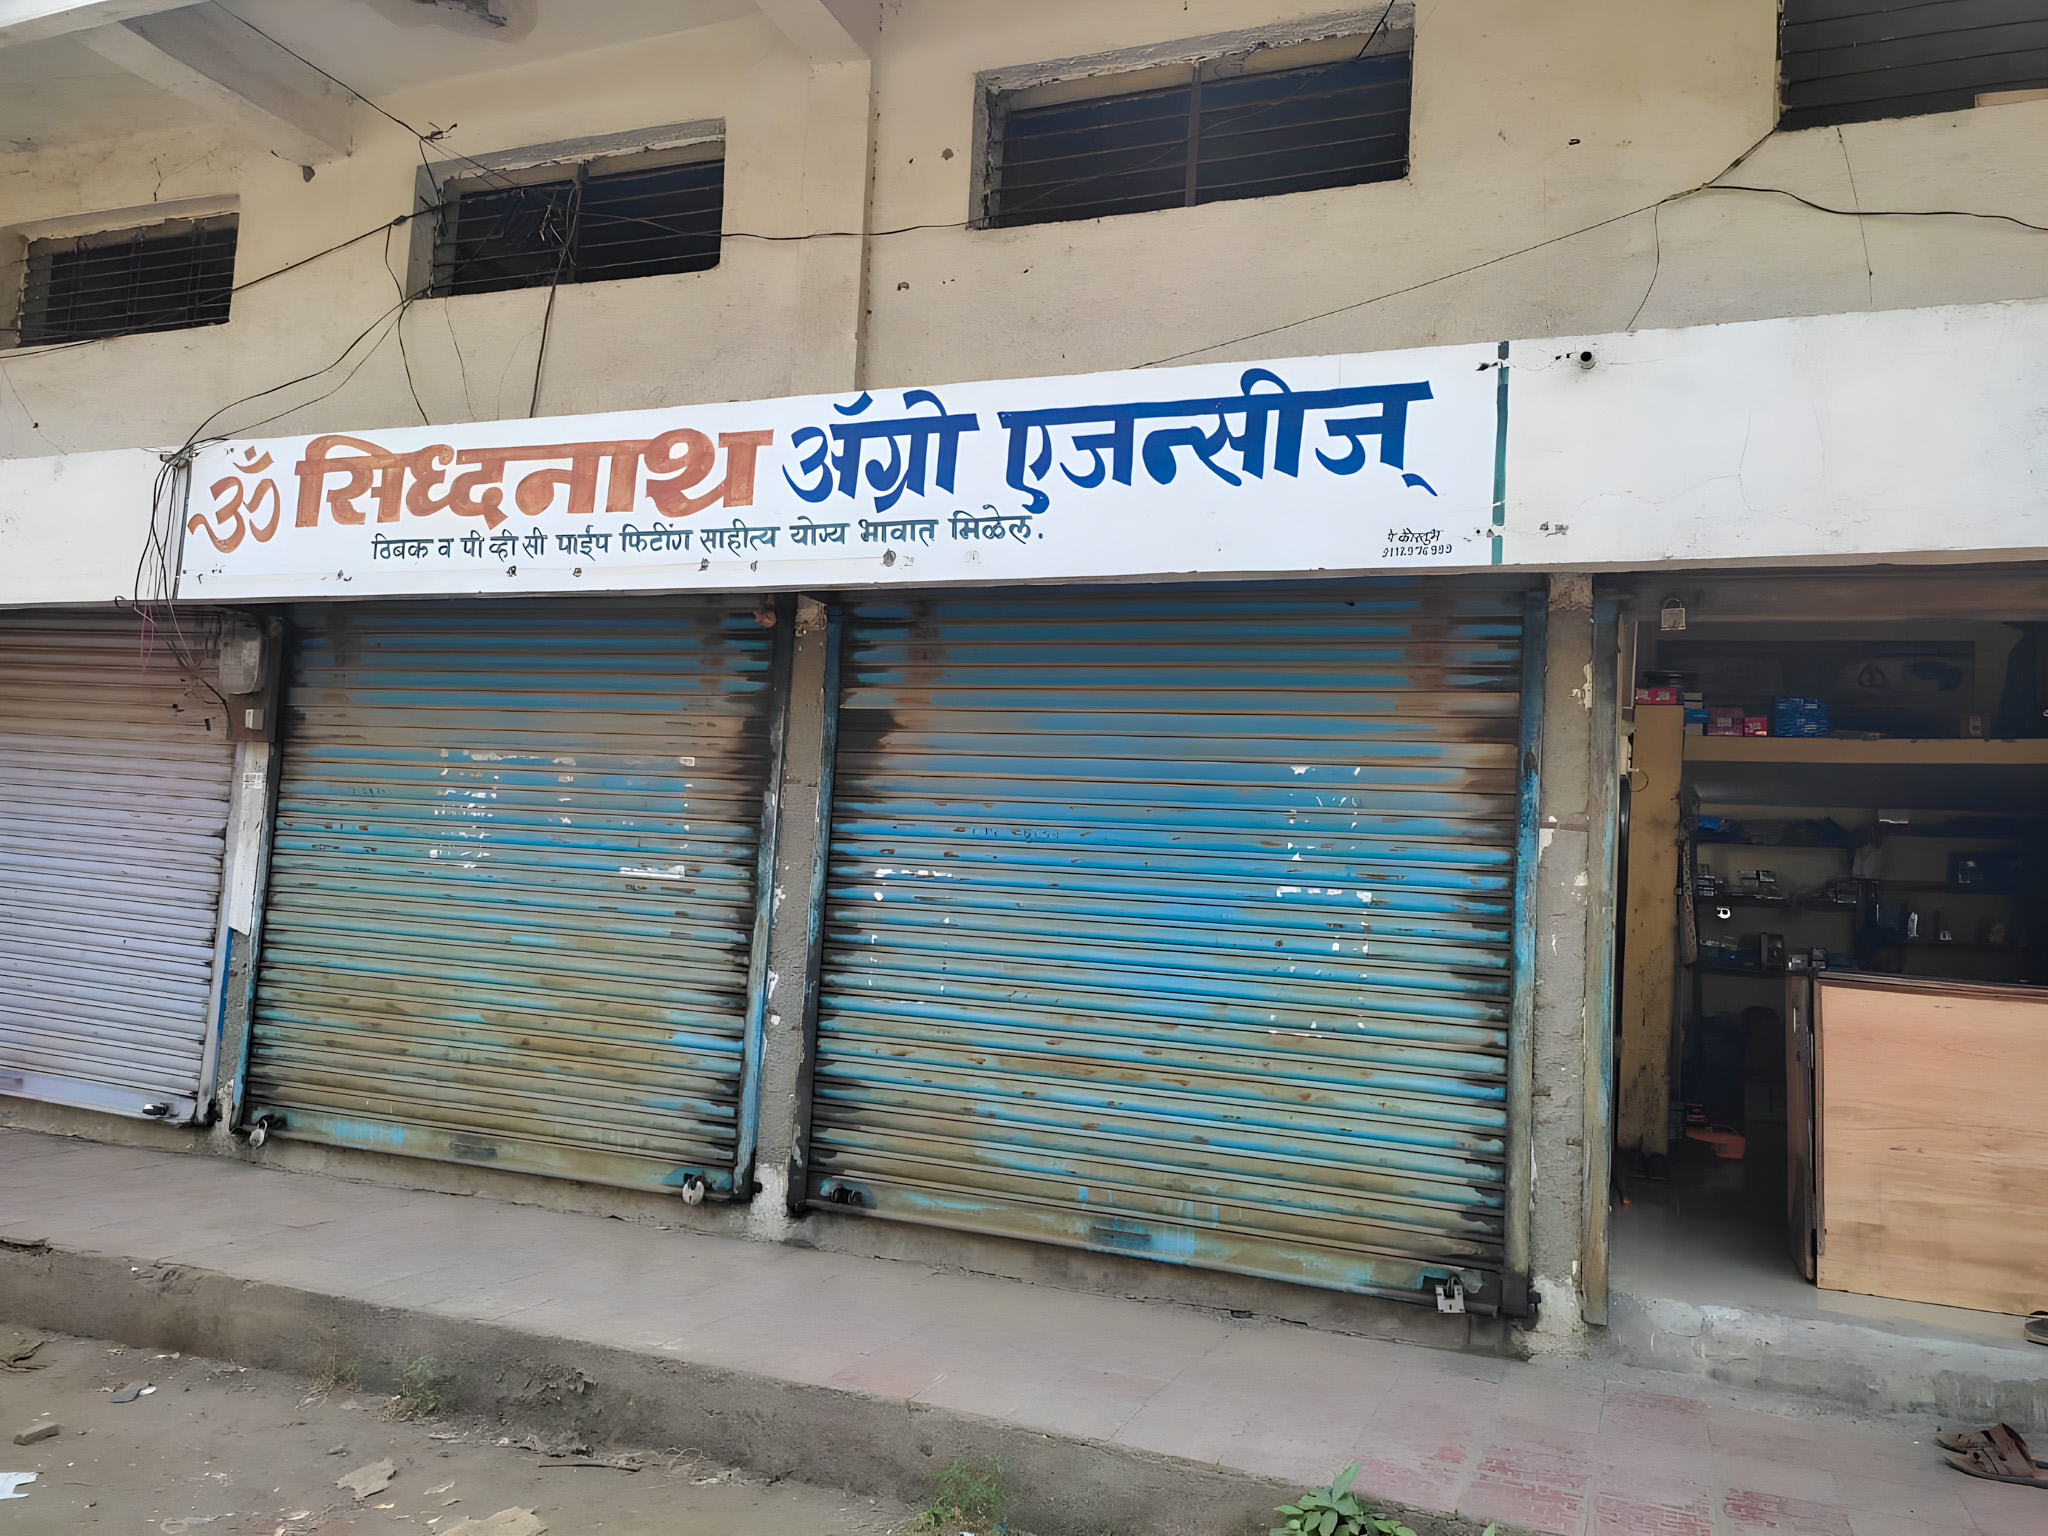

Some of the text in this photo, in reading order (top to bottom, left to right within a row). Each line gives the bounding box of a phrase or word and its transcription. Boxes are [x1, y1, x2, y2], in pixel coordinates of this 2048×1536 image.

[438, 538, 454, 558] व
[460, 530, 484, 558] पी
[489, 529, 519, 562] व्ही
[522, 527, 547, 558] सी
[555, 525, 612, 561] पाईप
[700, 518, 780, 557] साहीत्य
[789, 515, 850, 546] योग्य
[858, 519, 939, 547] भावात
